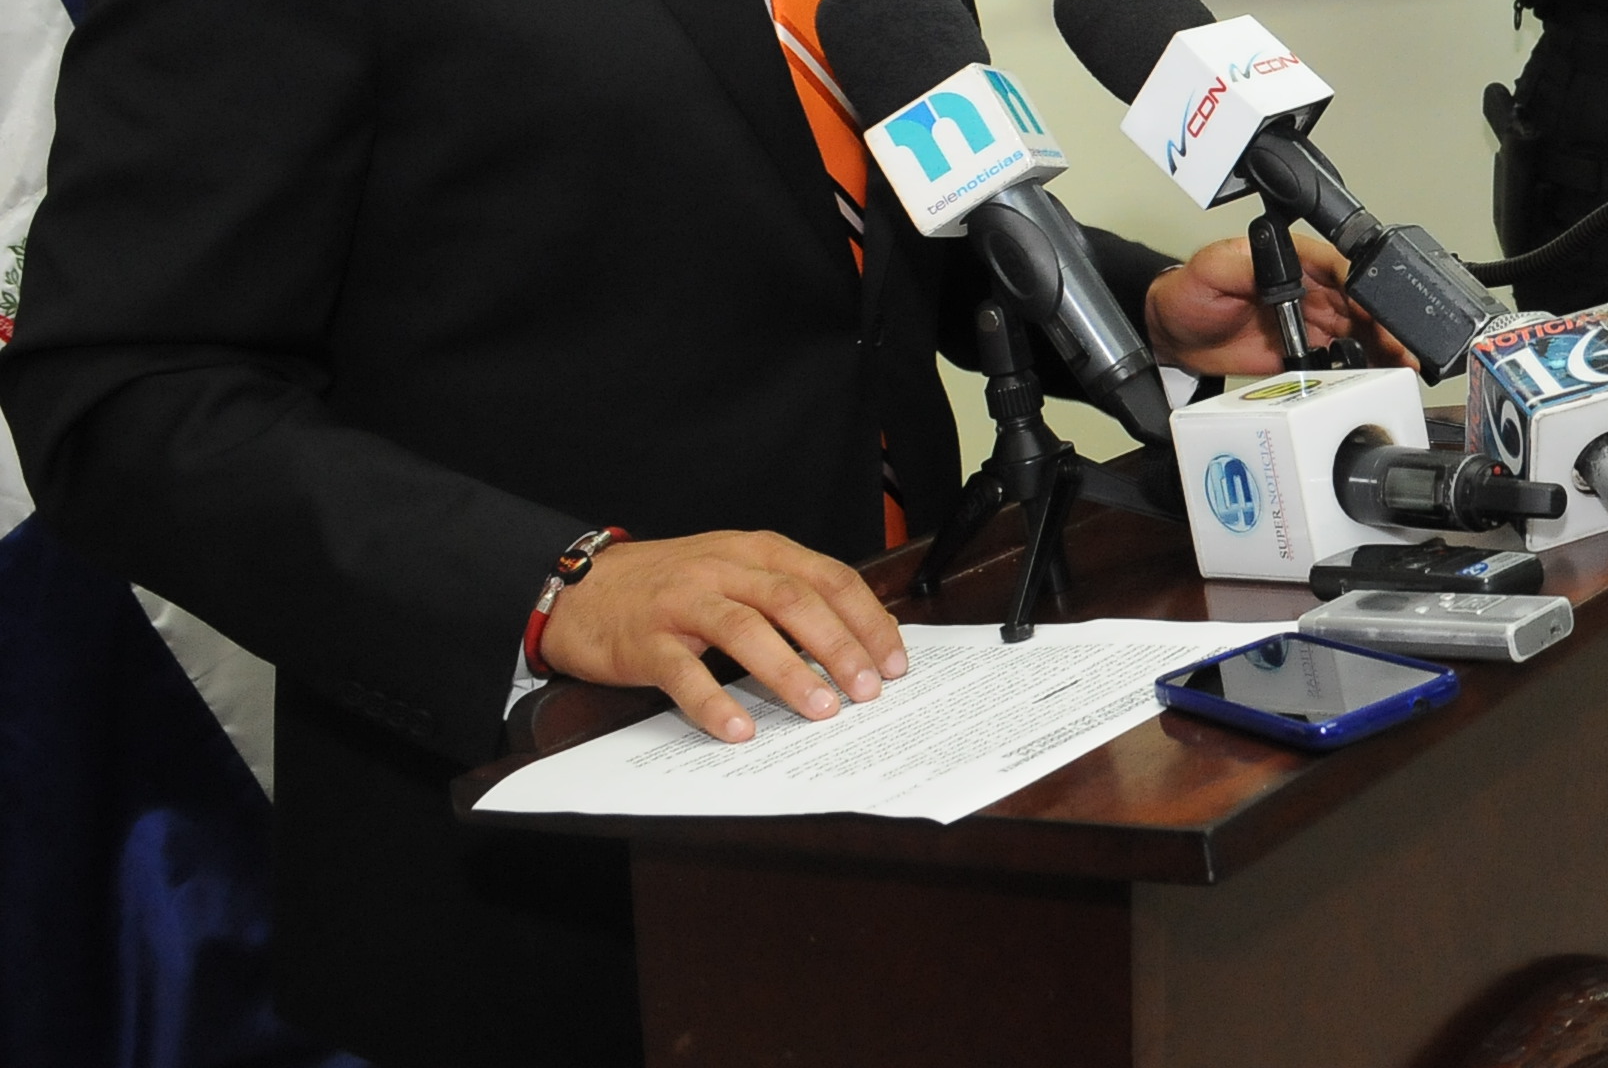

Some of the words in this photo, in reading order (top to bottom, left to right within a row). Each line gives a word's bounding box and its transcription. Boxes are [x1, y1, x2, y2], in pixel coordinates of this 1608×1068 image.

[1253, 51, 1300, 75] CDN
[1187, 76, 1227, 138] CDN
[927, 150, 1024, 216] telenoticias
[1256, 430, 1279, 504] NOTICIAS
[1273, 509, 1289, 559] SUPER
